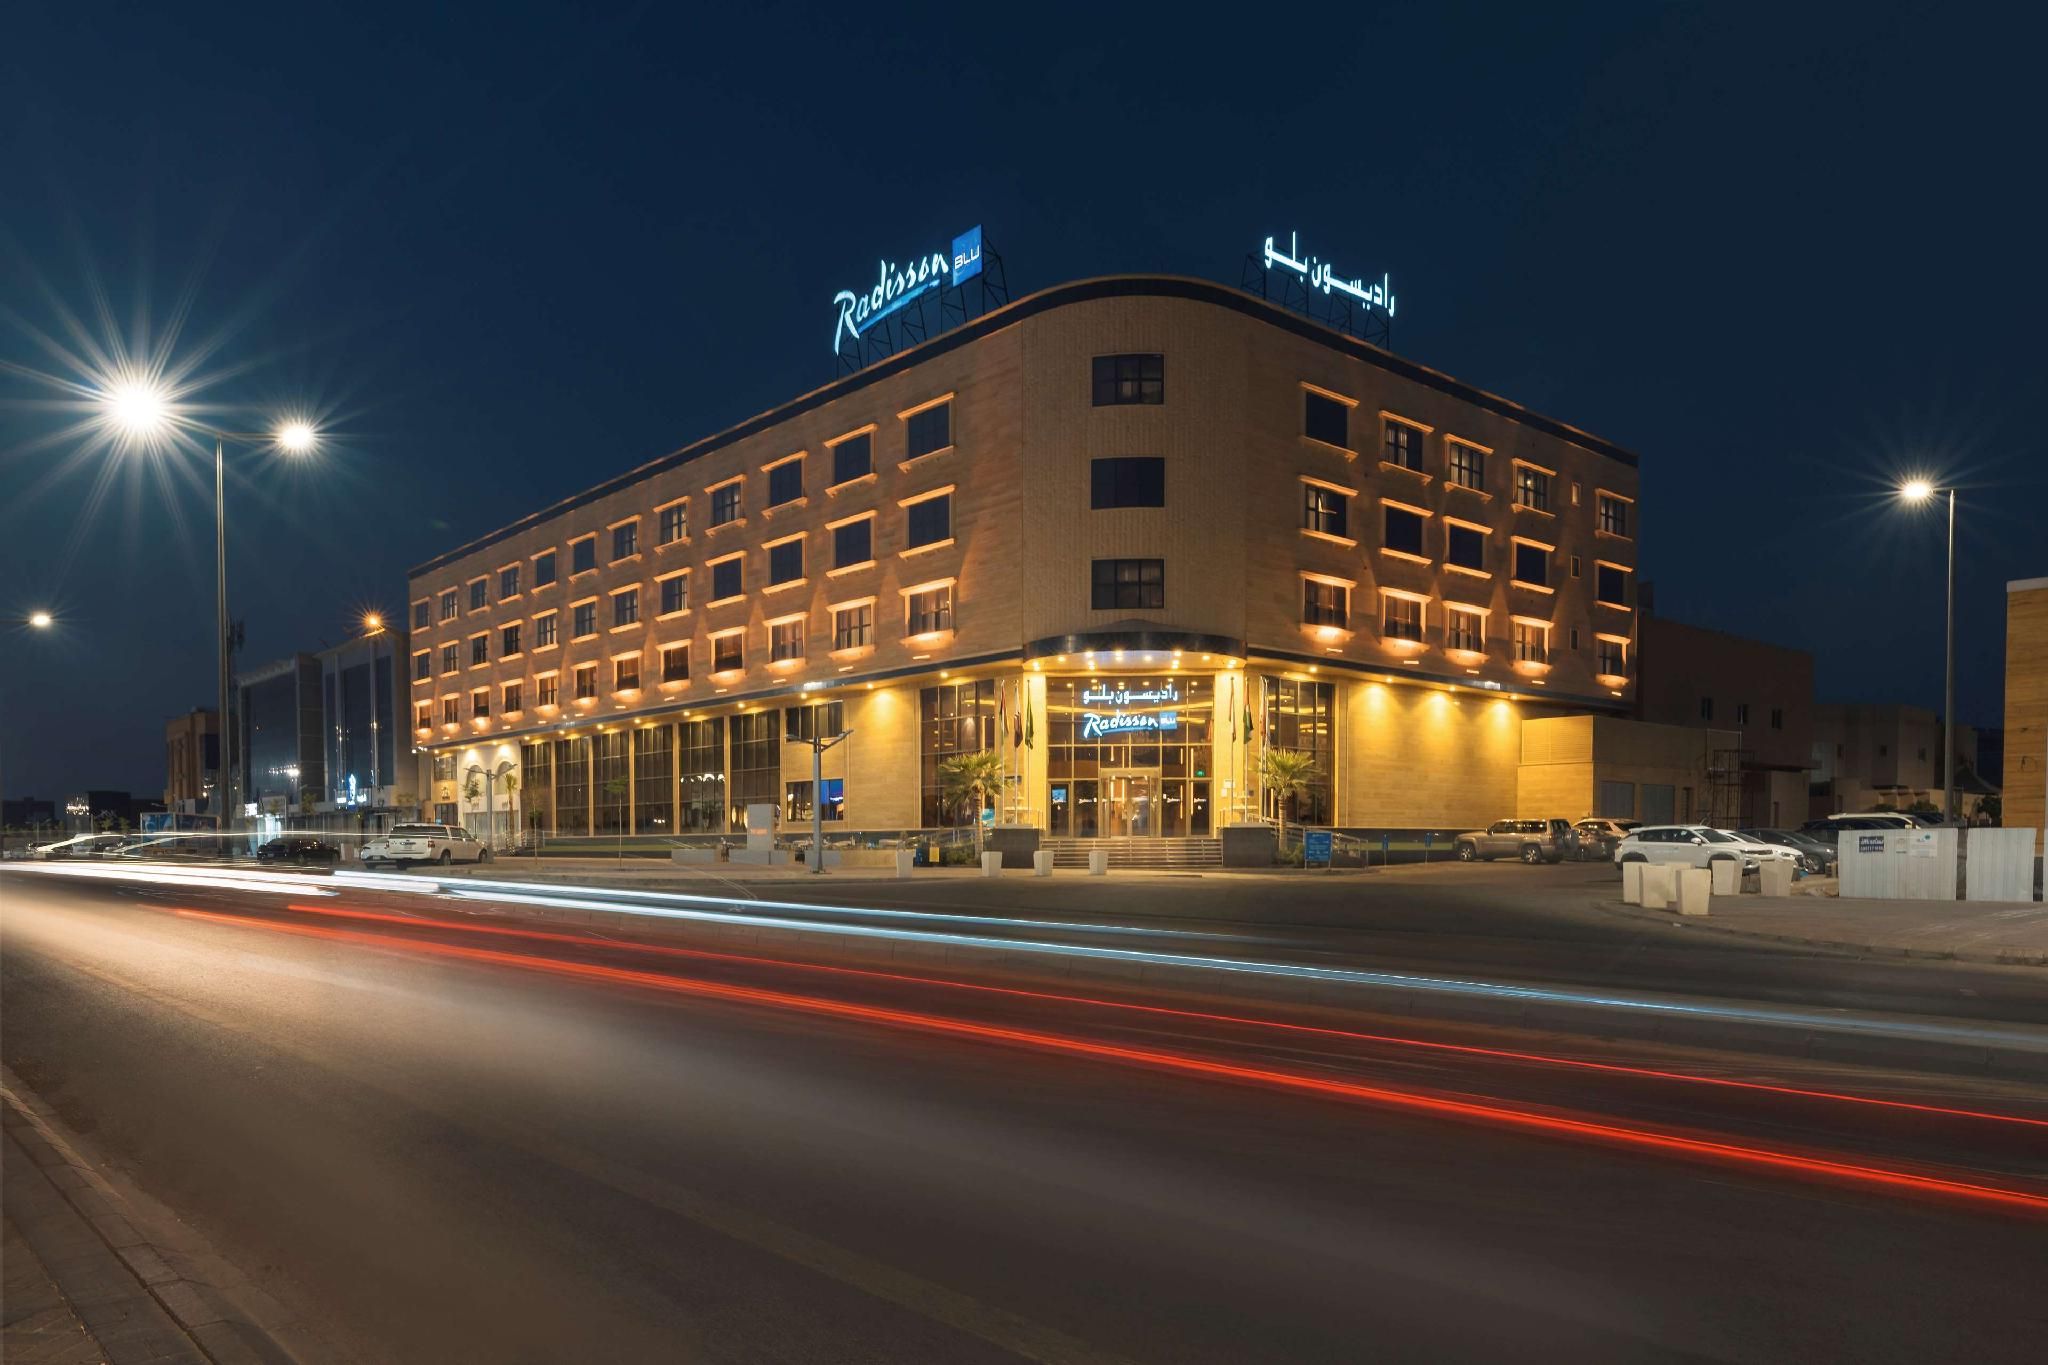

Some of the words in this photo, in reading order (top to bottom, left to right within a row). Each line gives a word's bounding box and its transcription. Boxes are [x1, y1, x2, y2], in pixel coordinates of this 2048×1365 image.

[1264, 230, 1308, 283] بلو
[834, 253, 949, 356] Radisson
[954, 245, 980, 270] BLU
[1311, 256, 1395, 317] راديسون
[1083, 683, 1114, 705] بلو
[1115, 683, 1178, 704] راديسون
[1083, 709, 1158, 738] Radisson
